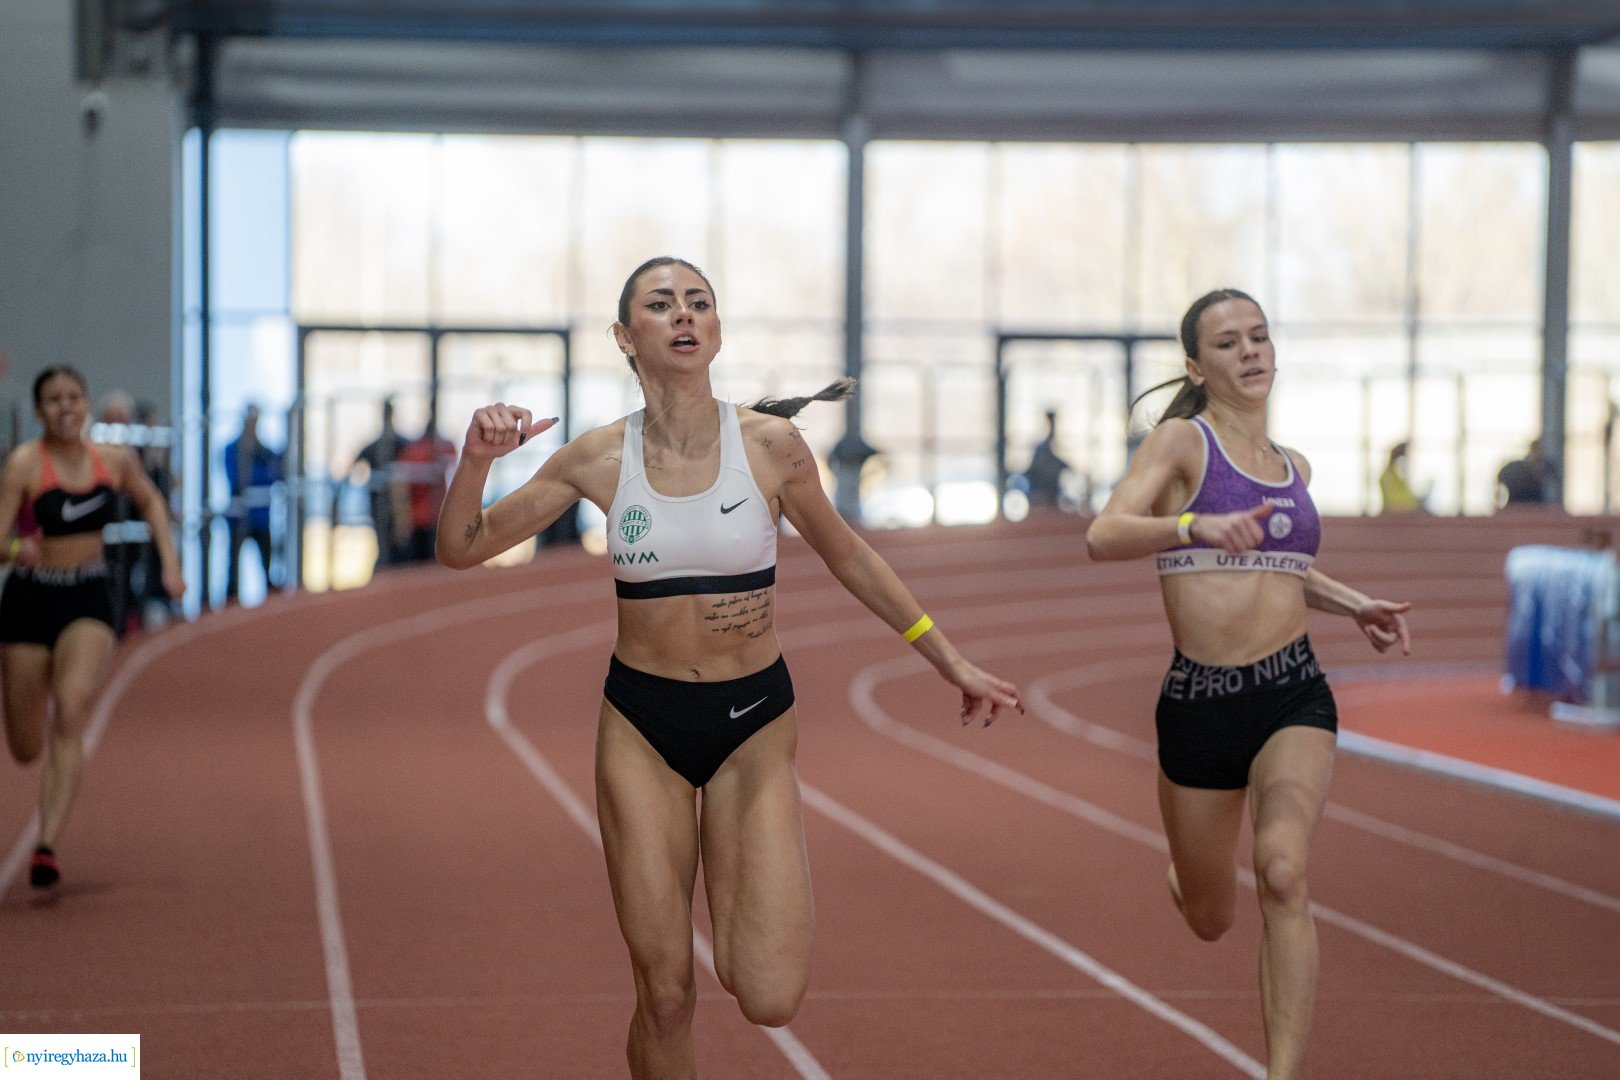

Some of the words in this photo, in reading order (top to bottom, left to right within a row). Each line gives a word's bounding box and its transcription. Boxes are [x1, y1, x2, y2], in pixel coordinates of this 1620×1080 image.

[613, 551, 659, 565] MVM
[1217, 554, 1248, 566] UTE
[1189, 672, 1243, 699] PRO
[1255, 635, 1309, 686] NIKE
